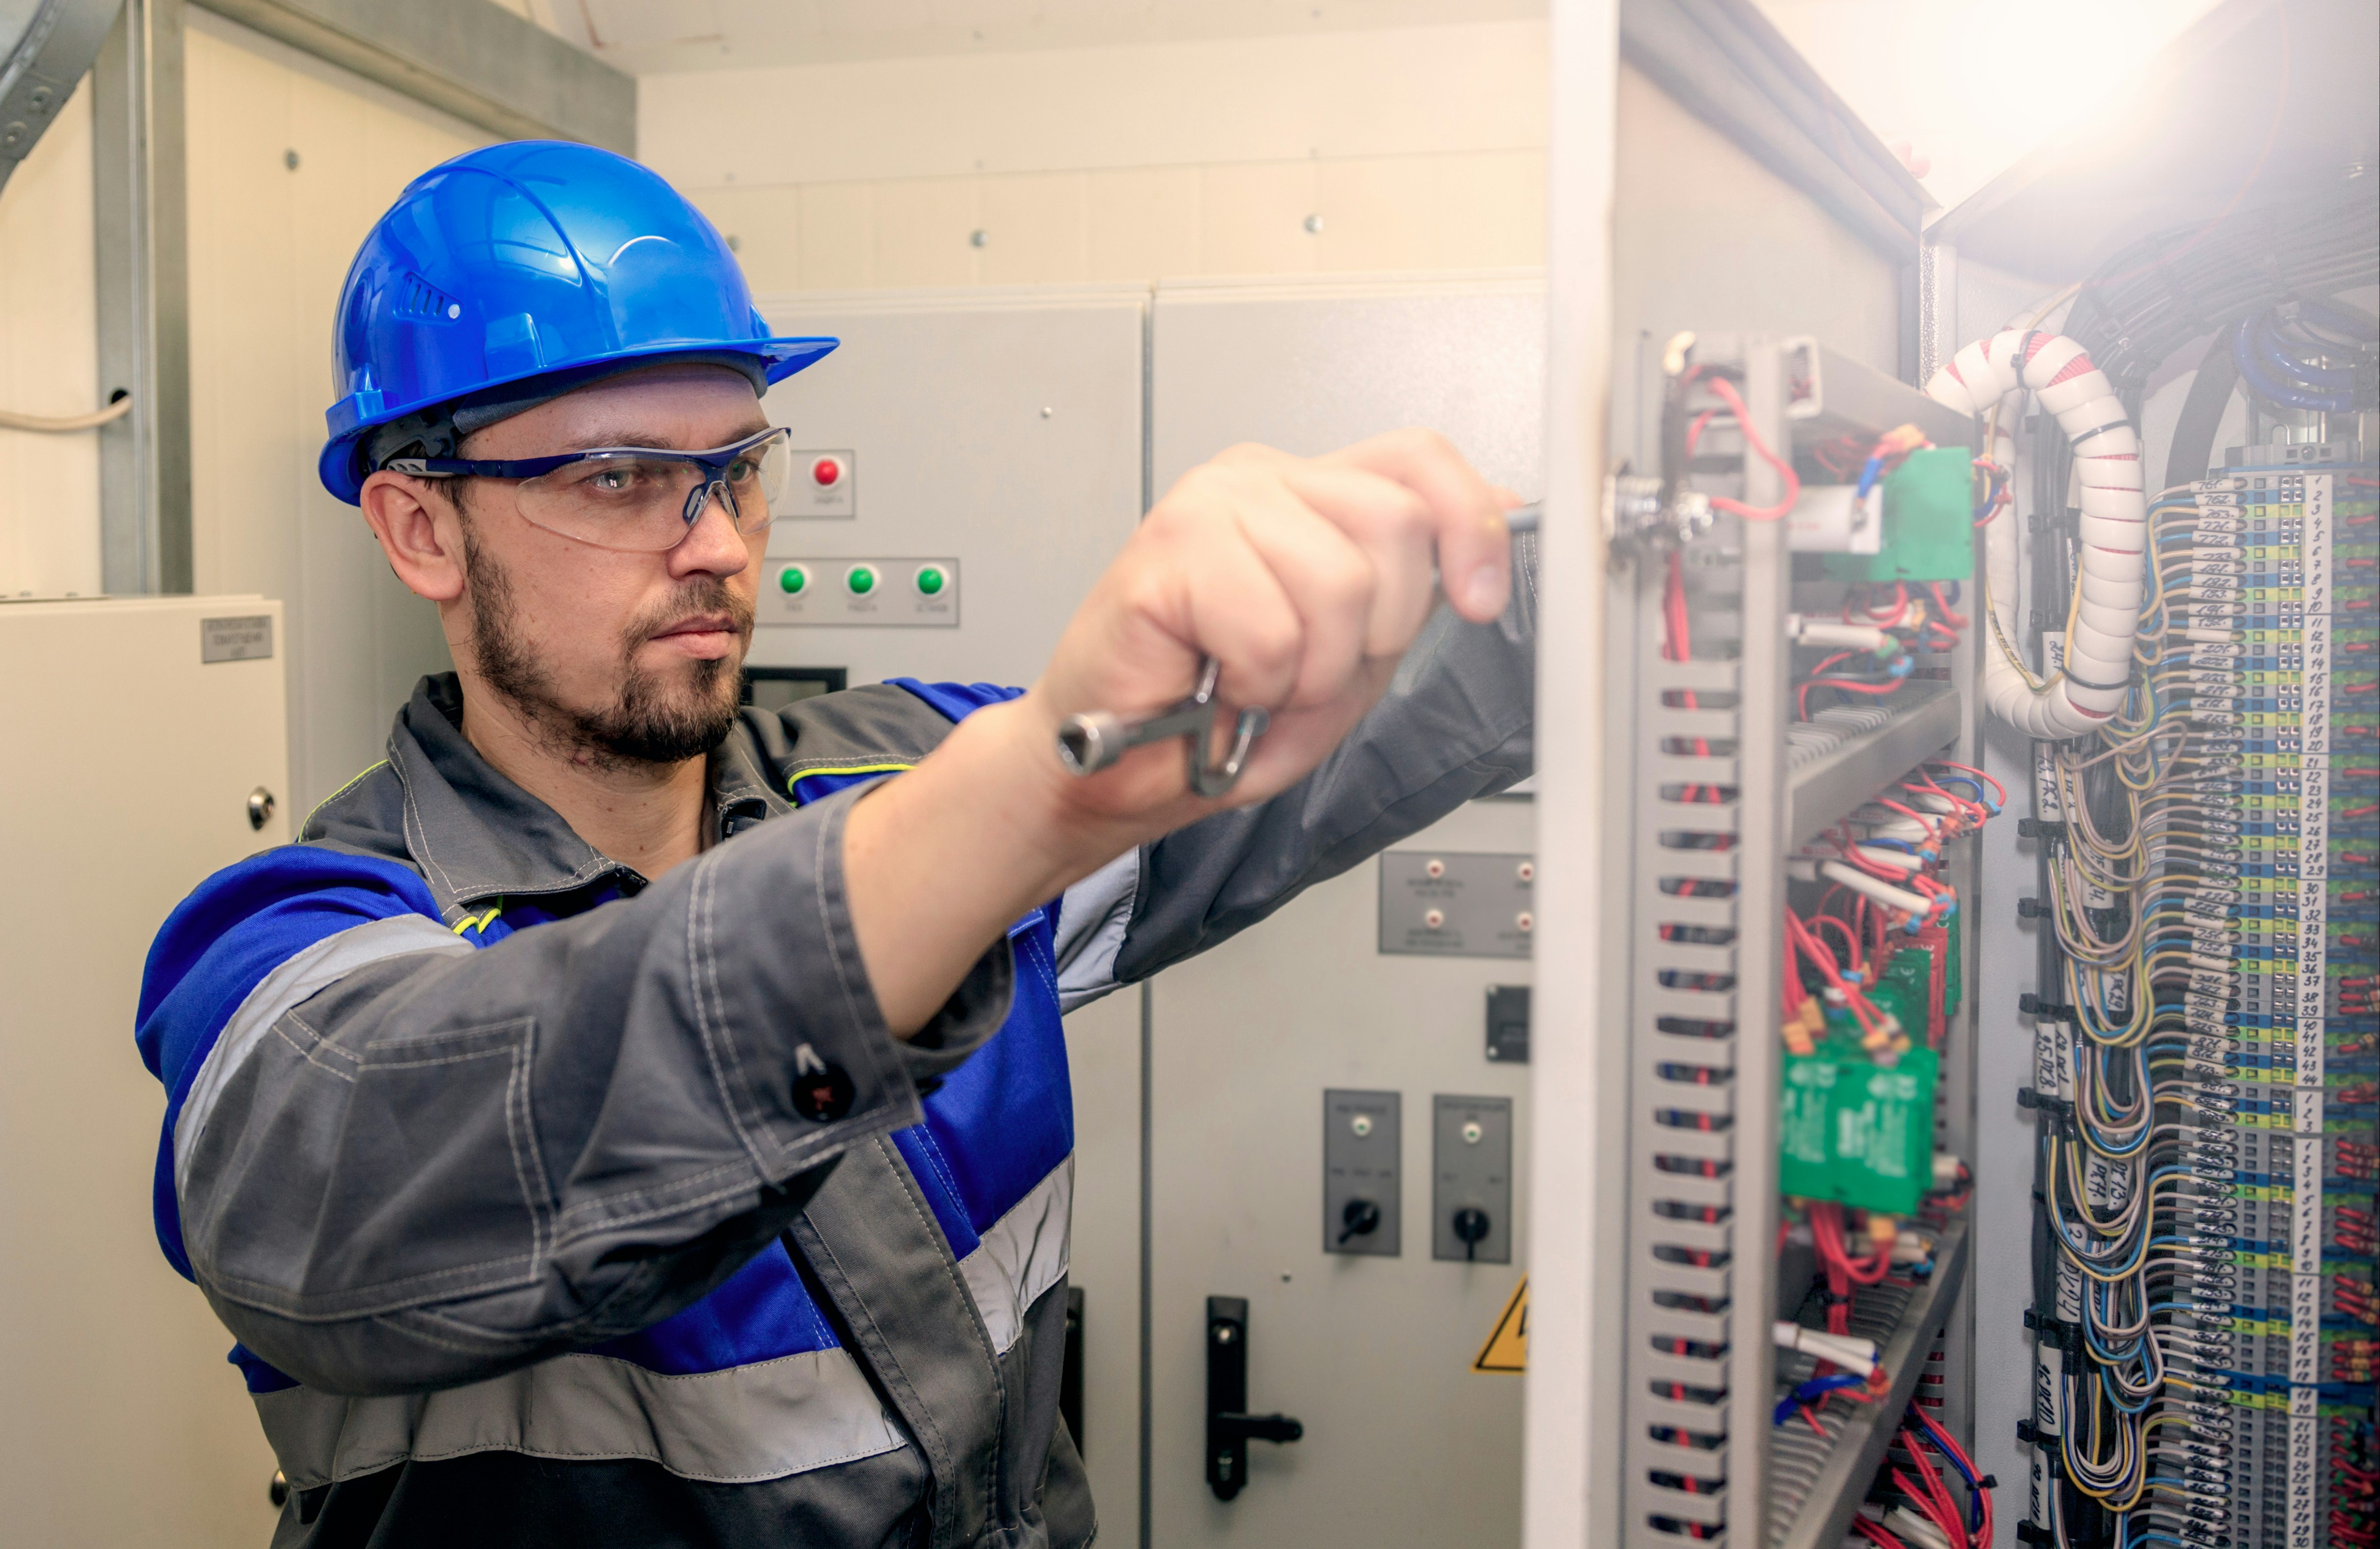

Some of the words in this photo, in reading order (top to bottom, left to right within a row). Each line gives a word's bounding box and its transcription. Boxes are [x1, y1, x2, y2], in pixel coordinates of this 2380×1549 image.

[2315, 476, 2322, 484] 1
[2313, 490, 2322, 501] 2
[2311, 504, 2321, 515] 3
[2314, 517, 2322, 529] 4
[2313, 531, 2325, 542] 5
[2312, 546, 2322, 556] 6
[2314, 560, 2321, 570] 7
[2311, 573, 2321, 585] 8
[2312, 588, 2322, 600] 9
[2308, 601, 2322, 614] 10
[2311, 618, 2323, 628] 11
[2311, 631, 2323, 641] 12
[2311, 643, 2323, 654] 13
[2311, 658, 2325, 670] 14
[2309, 672, 2327, 685] 15
[2309, 686, 2323, 696] 16
[2309, 700, 2325, 713] 17
[2309, 713, 2323, 725] 18
[2309, 725, 2323, 738] 19
[2307, 740, 2323, 751] 20
[2306, 757, 2319, 768] 21
[2306, 771, 2321, 783] 22
[2308, 785, 2321, 796] 23
[2306, 798, 2322, 809] 24
[2305, 812, 2323, 822] 25
[2306, 827, 2321, 836] 26
[2305, 839, 2320, 851] 27
[2305, 853, 2322, 863] 28
[2306, 865, 2324, 876] 29
[2304, 882, 2319, 894] 30
[2302, 896, 2317, 907] 31
[2305, 909, 2321, 921] 32
[2304, 924, 2320, 935] 33
[2302, 937, 2318, 949] 34
[2303, 951, 2322, 962] 35
[2302, 963, 2317, 974] 36
[2304, 976, 2320, 987] 37
[2302, 992, 2319, 1003] 38
[2301, 1005, 2318, 1016] 39
[2303, 1020, 2317, 1031] 40
[2302, 1031, 2317, 1043] 41
[2303, 1046, 2316, 1057] 42
[2301, 1060, 2316, 1071] 43
[2302, 1074, 2318, 1085] 44
[2305, 1094, 2312, 1103] 1
[2303, 1108, 2312, 1119] 2
[2303, 1121, 2312, 1132] 3
[2305, 1141, 2312, 1151] 1
[2302, 1154, 2310, 1164] 2
[2303, 1166, 2312, 1177] 3
[2303, 1180, 2311, 1191] 4
[2302, 1195, 2315, 1205] 5
[2302, 1207, 2312, 1217] 6
[2303, 1221, 2312, 1232] 7
[2302, 1249, 2310, 1258] 9
[2299, 1278, 2312, 1287] 11
[2297, 1292, 2311, 1302] 12
[2297, 1306, 2311, 1316] 13
[2297, 1318, 2312, 1329] 14
[2296, 1345, 2311, 1356] 16
[2295, 1359, 2311, 1368] 17
[2296, 1371, 2309, 1381] 18
[2298, 1390, 2312, 1400] 19
[2295, 1404, 2311, 1414] 20
[2294, 1422, 2310, 1432] 21
[2294, 1434, 2310, 1445] 22
[2294, 1446, 2309, 1458] 23
[2293, 1460, 2310, 1471] 24
[2292, 1472, 2311, 1484] 25
[2293, 1486, 2309, 1496] 26
[2293, 1499, 2310, 1510] 27
[2294, 1512, 2310, 1523] 28
[2292, 1525, 2309, 1536] 29
[2293, 1537, 2309, 1548] 30
